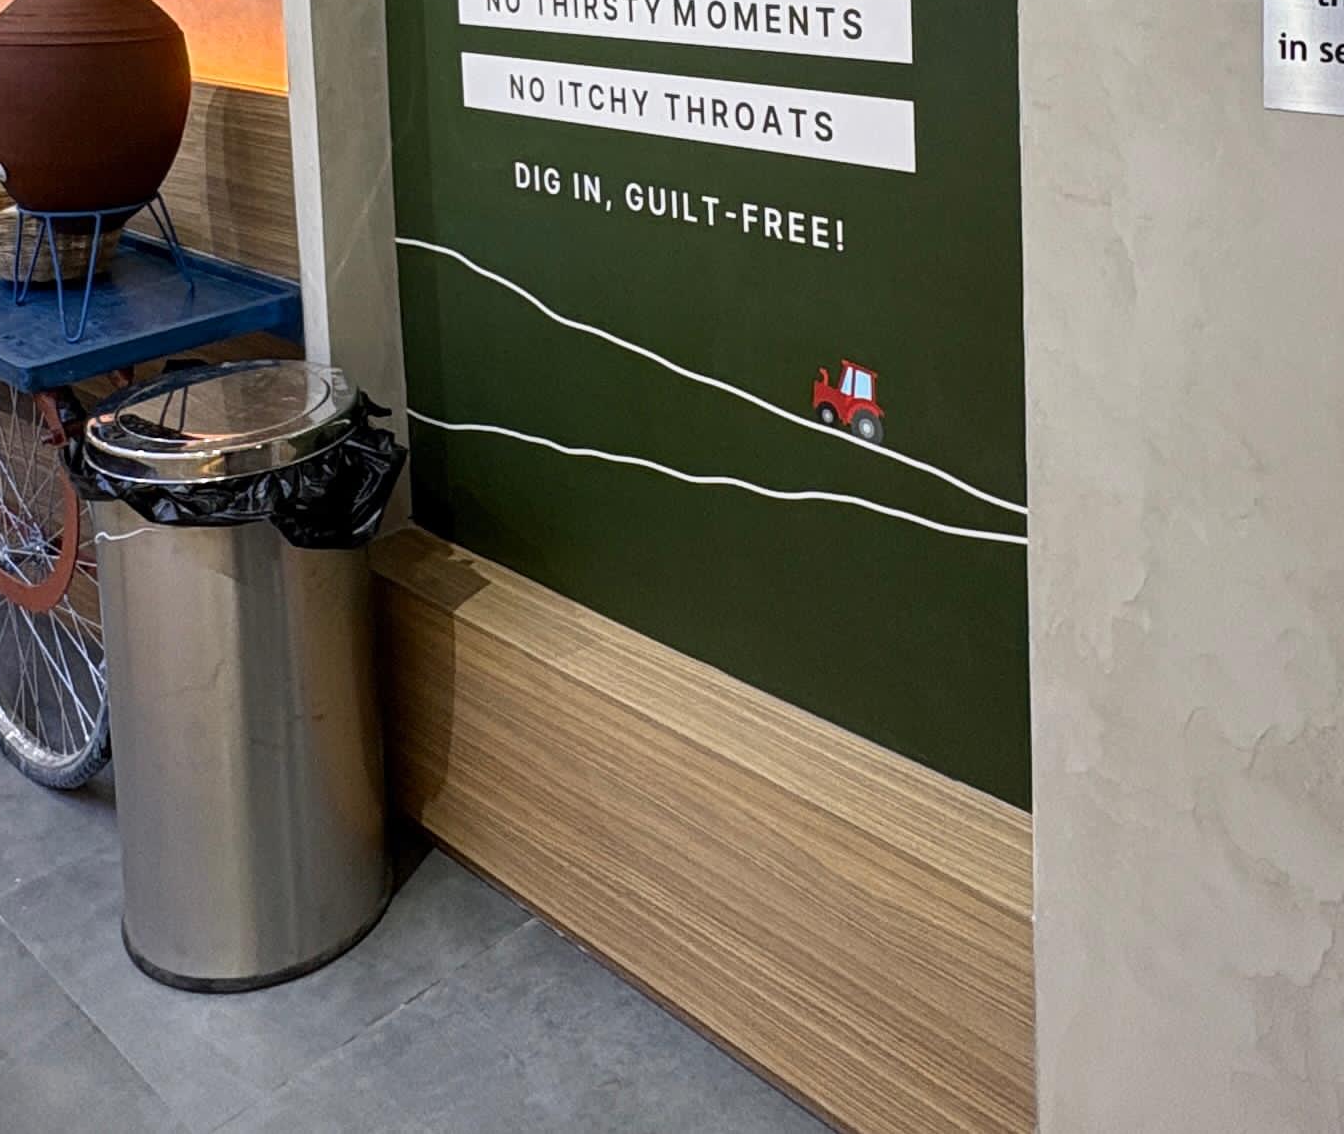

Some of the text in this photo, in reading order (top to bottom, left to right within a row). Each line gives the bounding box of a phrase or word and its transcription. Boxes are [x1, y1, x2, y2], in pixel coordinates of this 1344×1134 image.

[673, 0, 864, 40] MOMENTS
[1277, 33, 1308, 62] in
[510, 74, 834, 143] NO ITCHY THROATS
[514, 162, 845, 252] DIG IN, GUILT-FREE!
